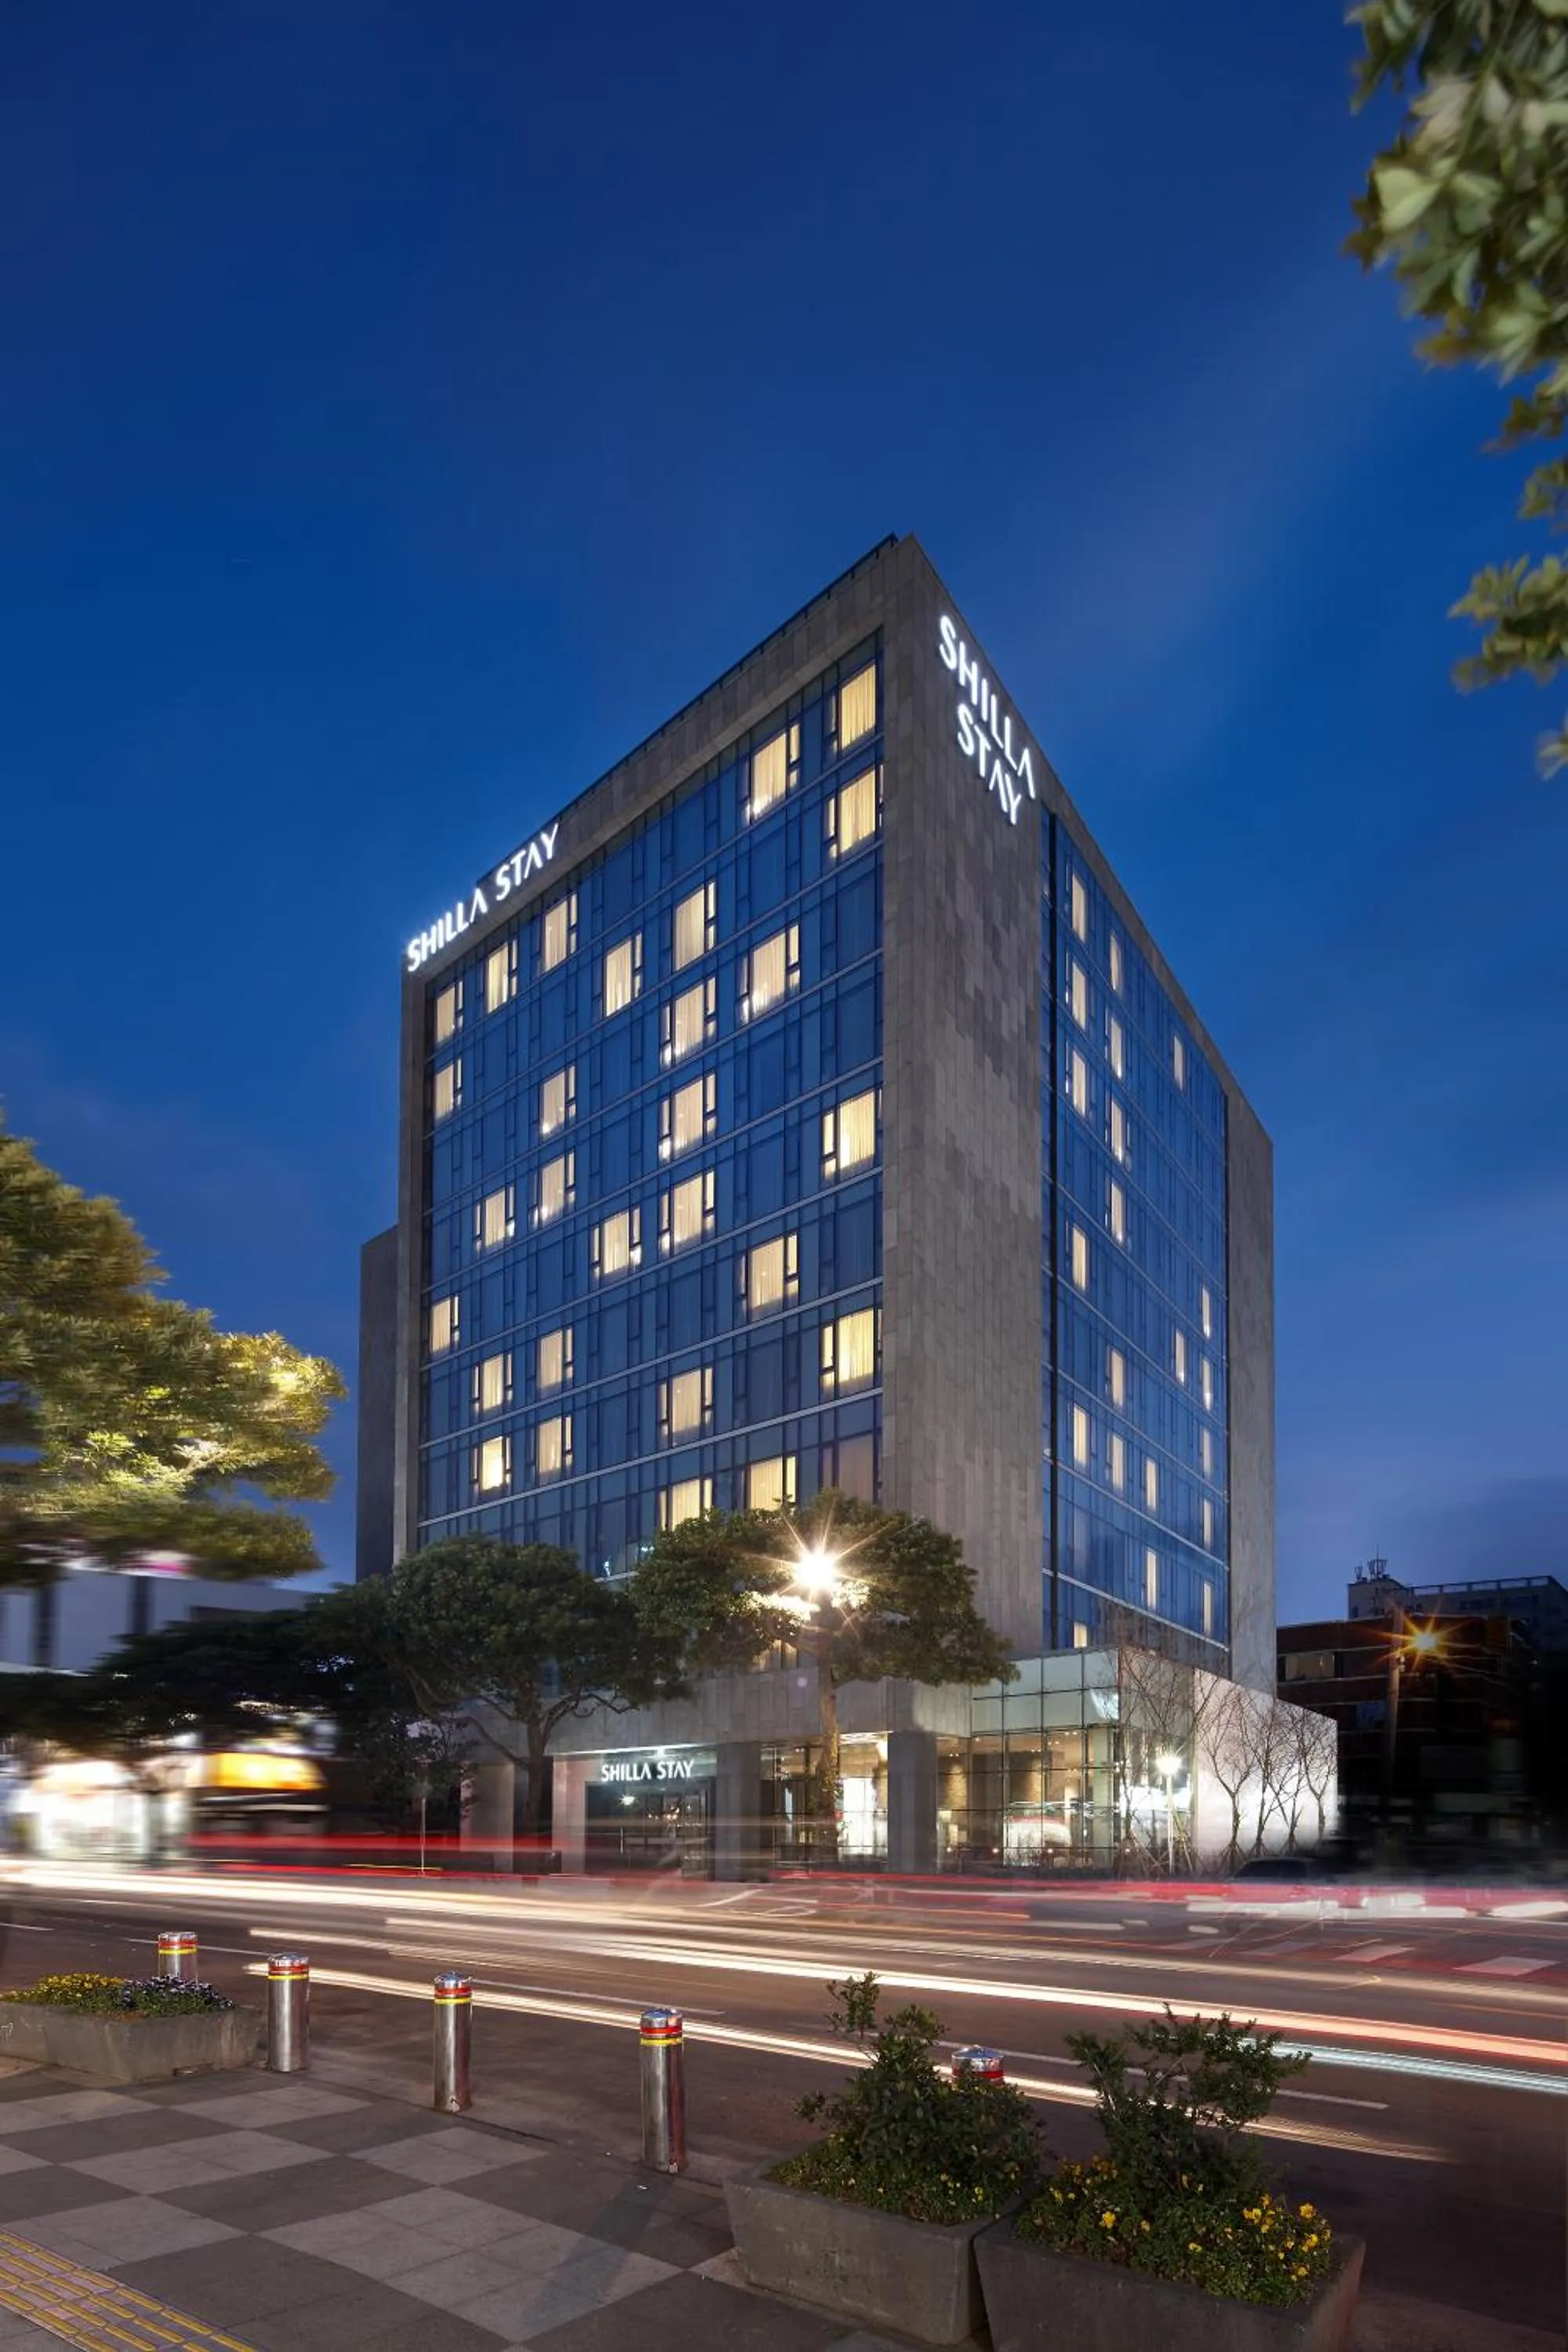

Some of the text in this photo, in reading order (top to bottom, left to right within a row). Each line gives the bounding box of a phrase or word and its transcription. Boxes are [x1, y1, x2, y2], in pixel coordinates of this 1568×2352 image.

[938, 615, 1035, 799] SHILLA
[957, 702, 1022, 825] STAY
[408, 823, 558, 972] SHILLA STAY
[601, 1759, 694, 1781] SHILLA STAY
